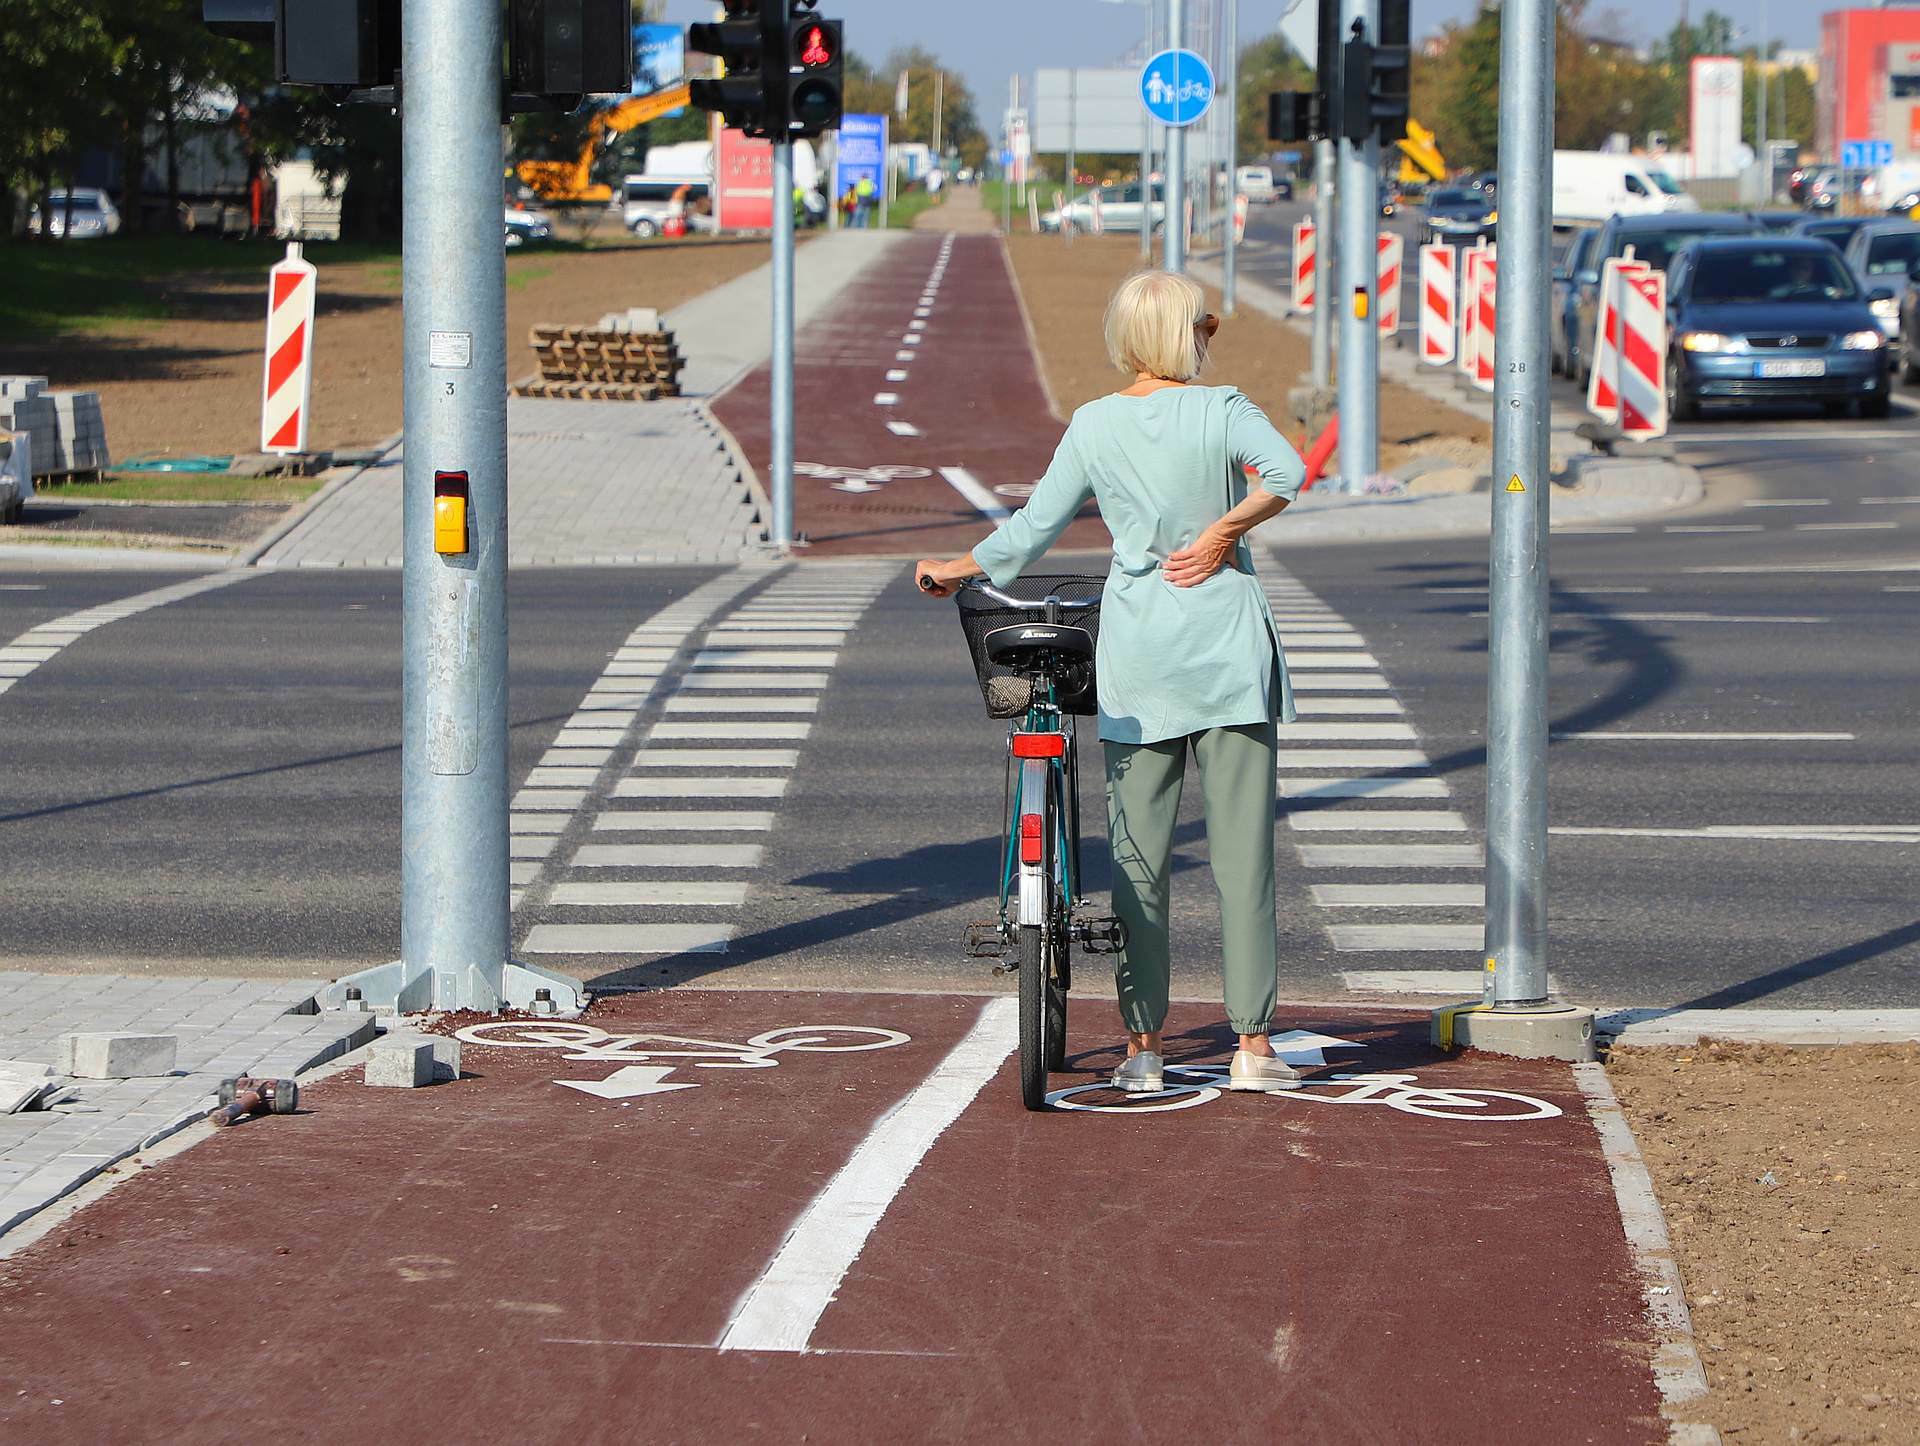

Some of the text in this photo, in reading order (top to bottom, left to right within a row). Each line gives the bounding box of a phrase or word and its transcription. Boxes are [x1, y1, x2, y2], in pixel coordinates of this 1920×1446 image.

[1509, 362, 1526, 373] 28
[445, 382, 455, 395] 3
[1020, 629, 1058, 639] AZIMUT
